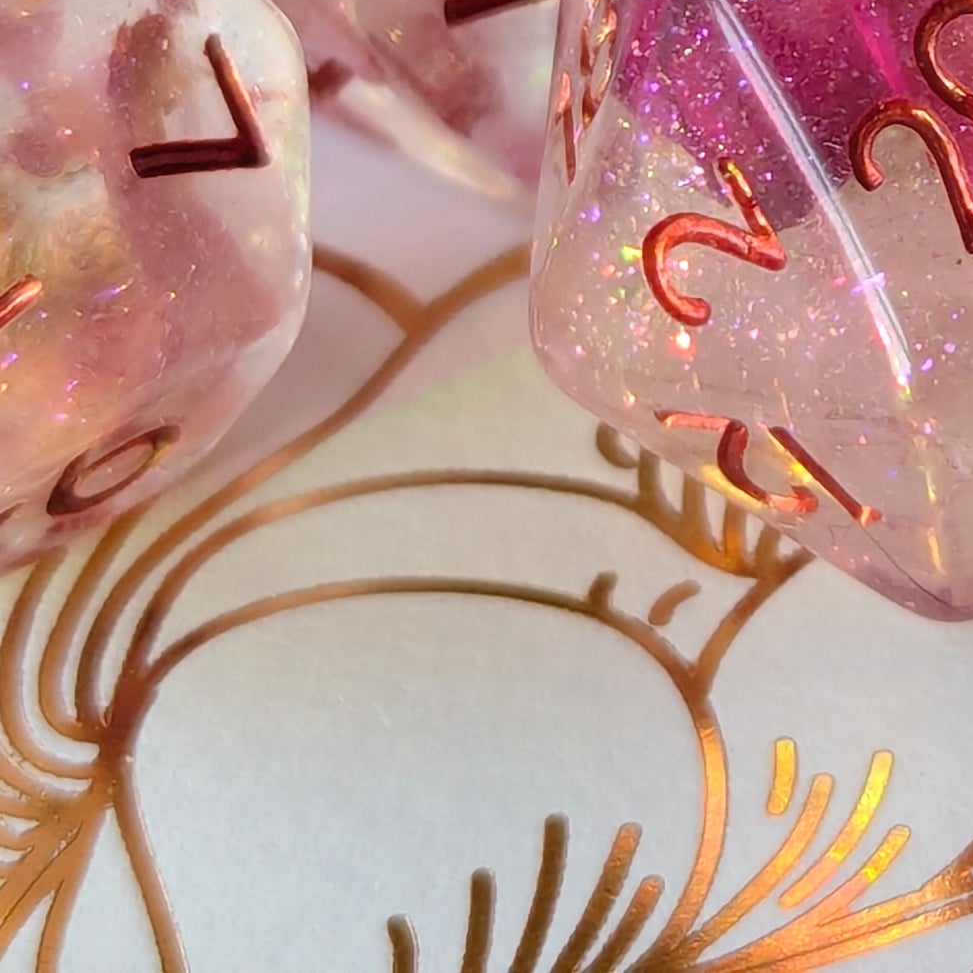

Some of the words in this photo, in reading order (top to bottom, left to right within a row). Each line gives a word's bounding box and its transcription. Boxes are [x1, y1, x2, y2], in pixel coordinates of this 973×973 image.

[130, 31, 272, 178] 7
[641, 156, 787, 327] 2
[653, 408, 884, 526] 12
